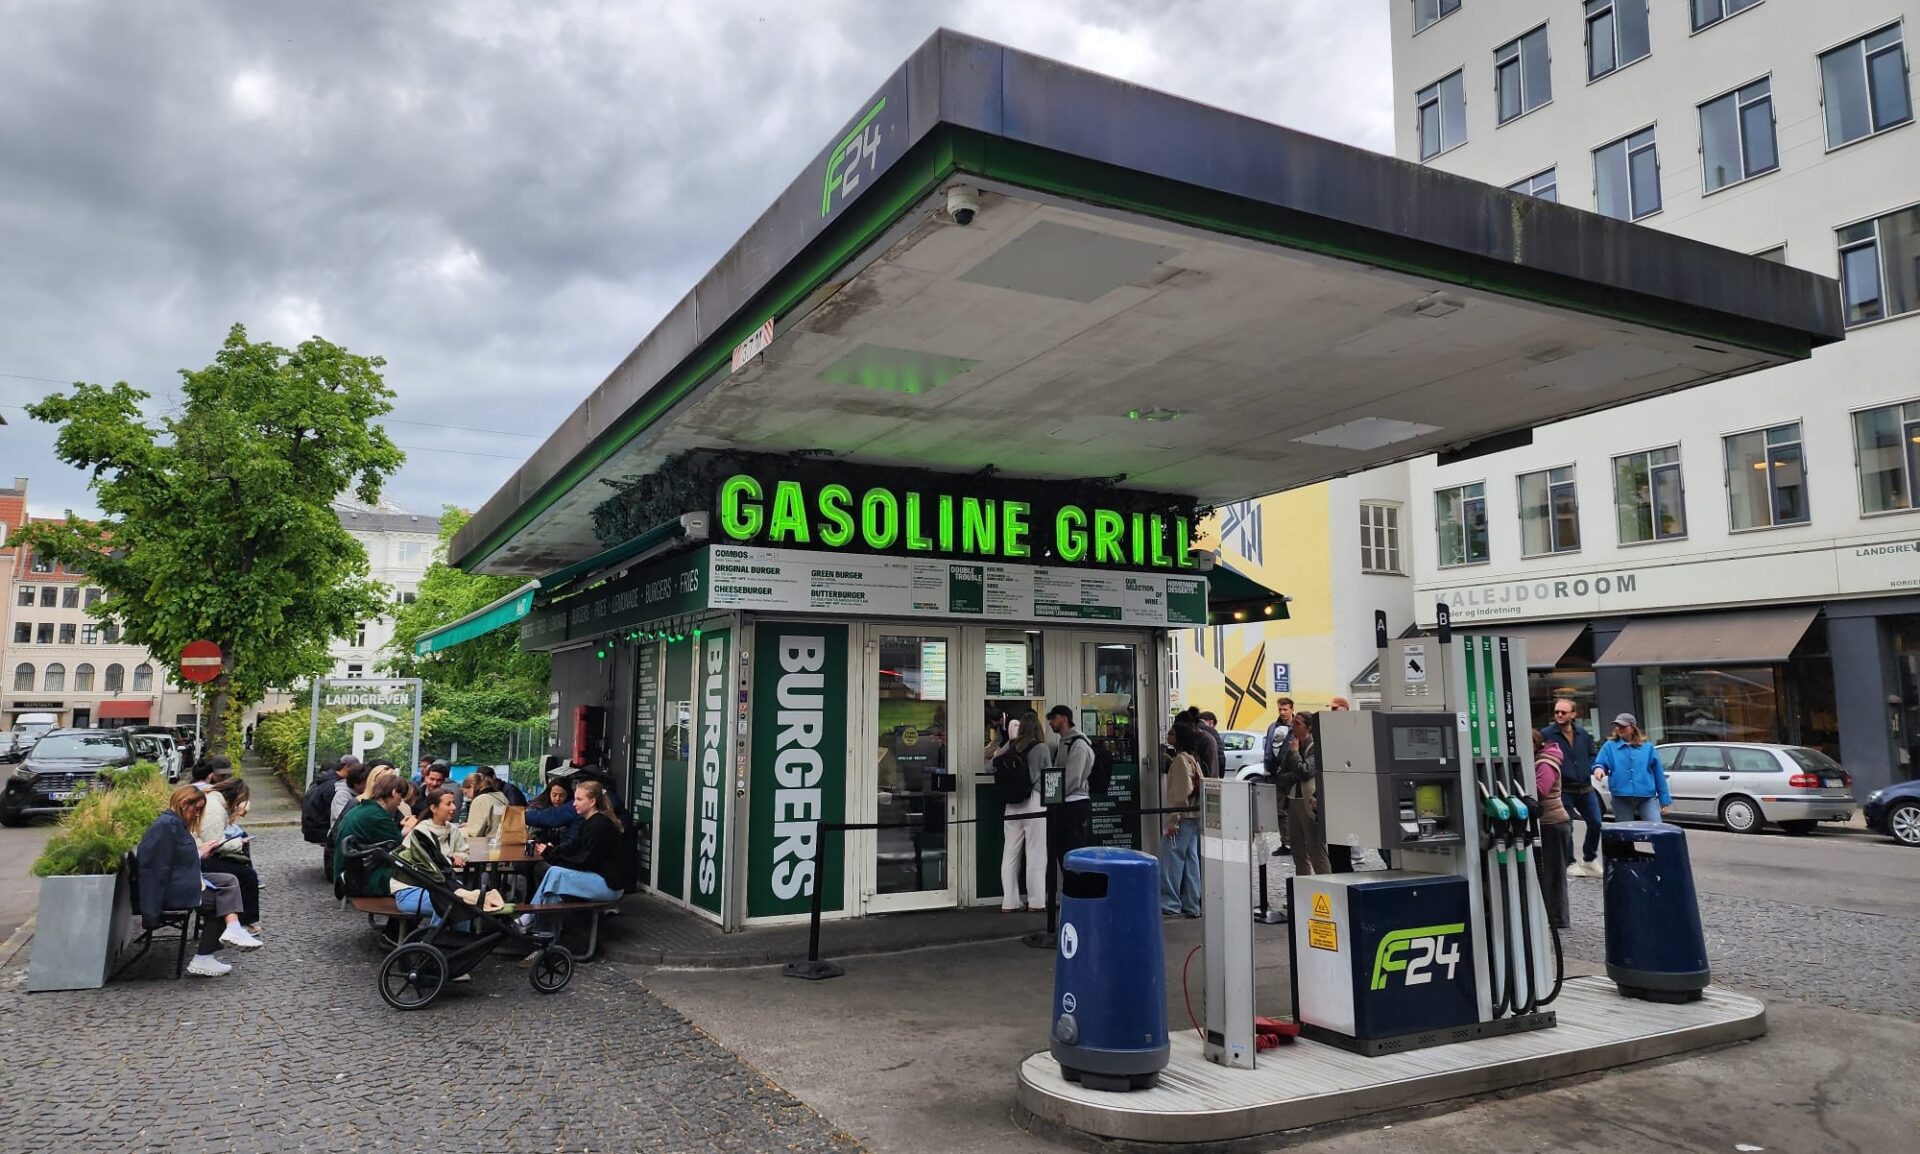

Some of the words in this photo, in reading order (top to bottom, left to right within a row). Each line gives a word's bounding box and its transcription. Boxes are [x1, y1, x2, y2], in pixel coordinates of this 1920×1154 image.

[720, 473, 1032, 558] GASOLINE
[1055, 504, 1202, 570] GRILL
[715, 549, 748, 559] COMBOS
[714, 564, 749, 573] ORIGINAL
[750, 566, 781, 575] BURGER
[811, 569, 834, 578] GREEN
[835, 571, 863, 579] BURGER
[950, 566, 975, 574] DOUBLE
[955, 573, 983, 582] TROUBLE
[1890, 579, 1920, 588] BORGE
[645, 576, 672, 604] BURGERS
[679, 568, 699, 594] FRIES
[714, 585, 772, 595] CHEESEBURGER
[1125, 584, 1154, 592] SELECTION
[1435, 574, 1637, 608] KALEJDOROOM
[811, 590, 865, 600] BUTTERBURGER
[1465, 609, 1475, 618] og
[1476, 605, 1521, 616] Indretning
[1376, 619, 1386, 631] A
[1439, 612, 1448, 625] B
[1276, 664, 1286, 680] P
[326, 693, 409, 706] LANDGREVEN
[352, 722, 385, 764] P
[700, 637, 724, 896] BURGERS
[771, 635, 826, 901] BURGERS
[1370, 923, 1466, 991] F24
